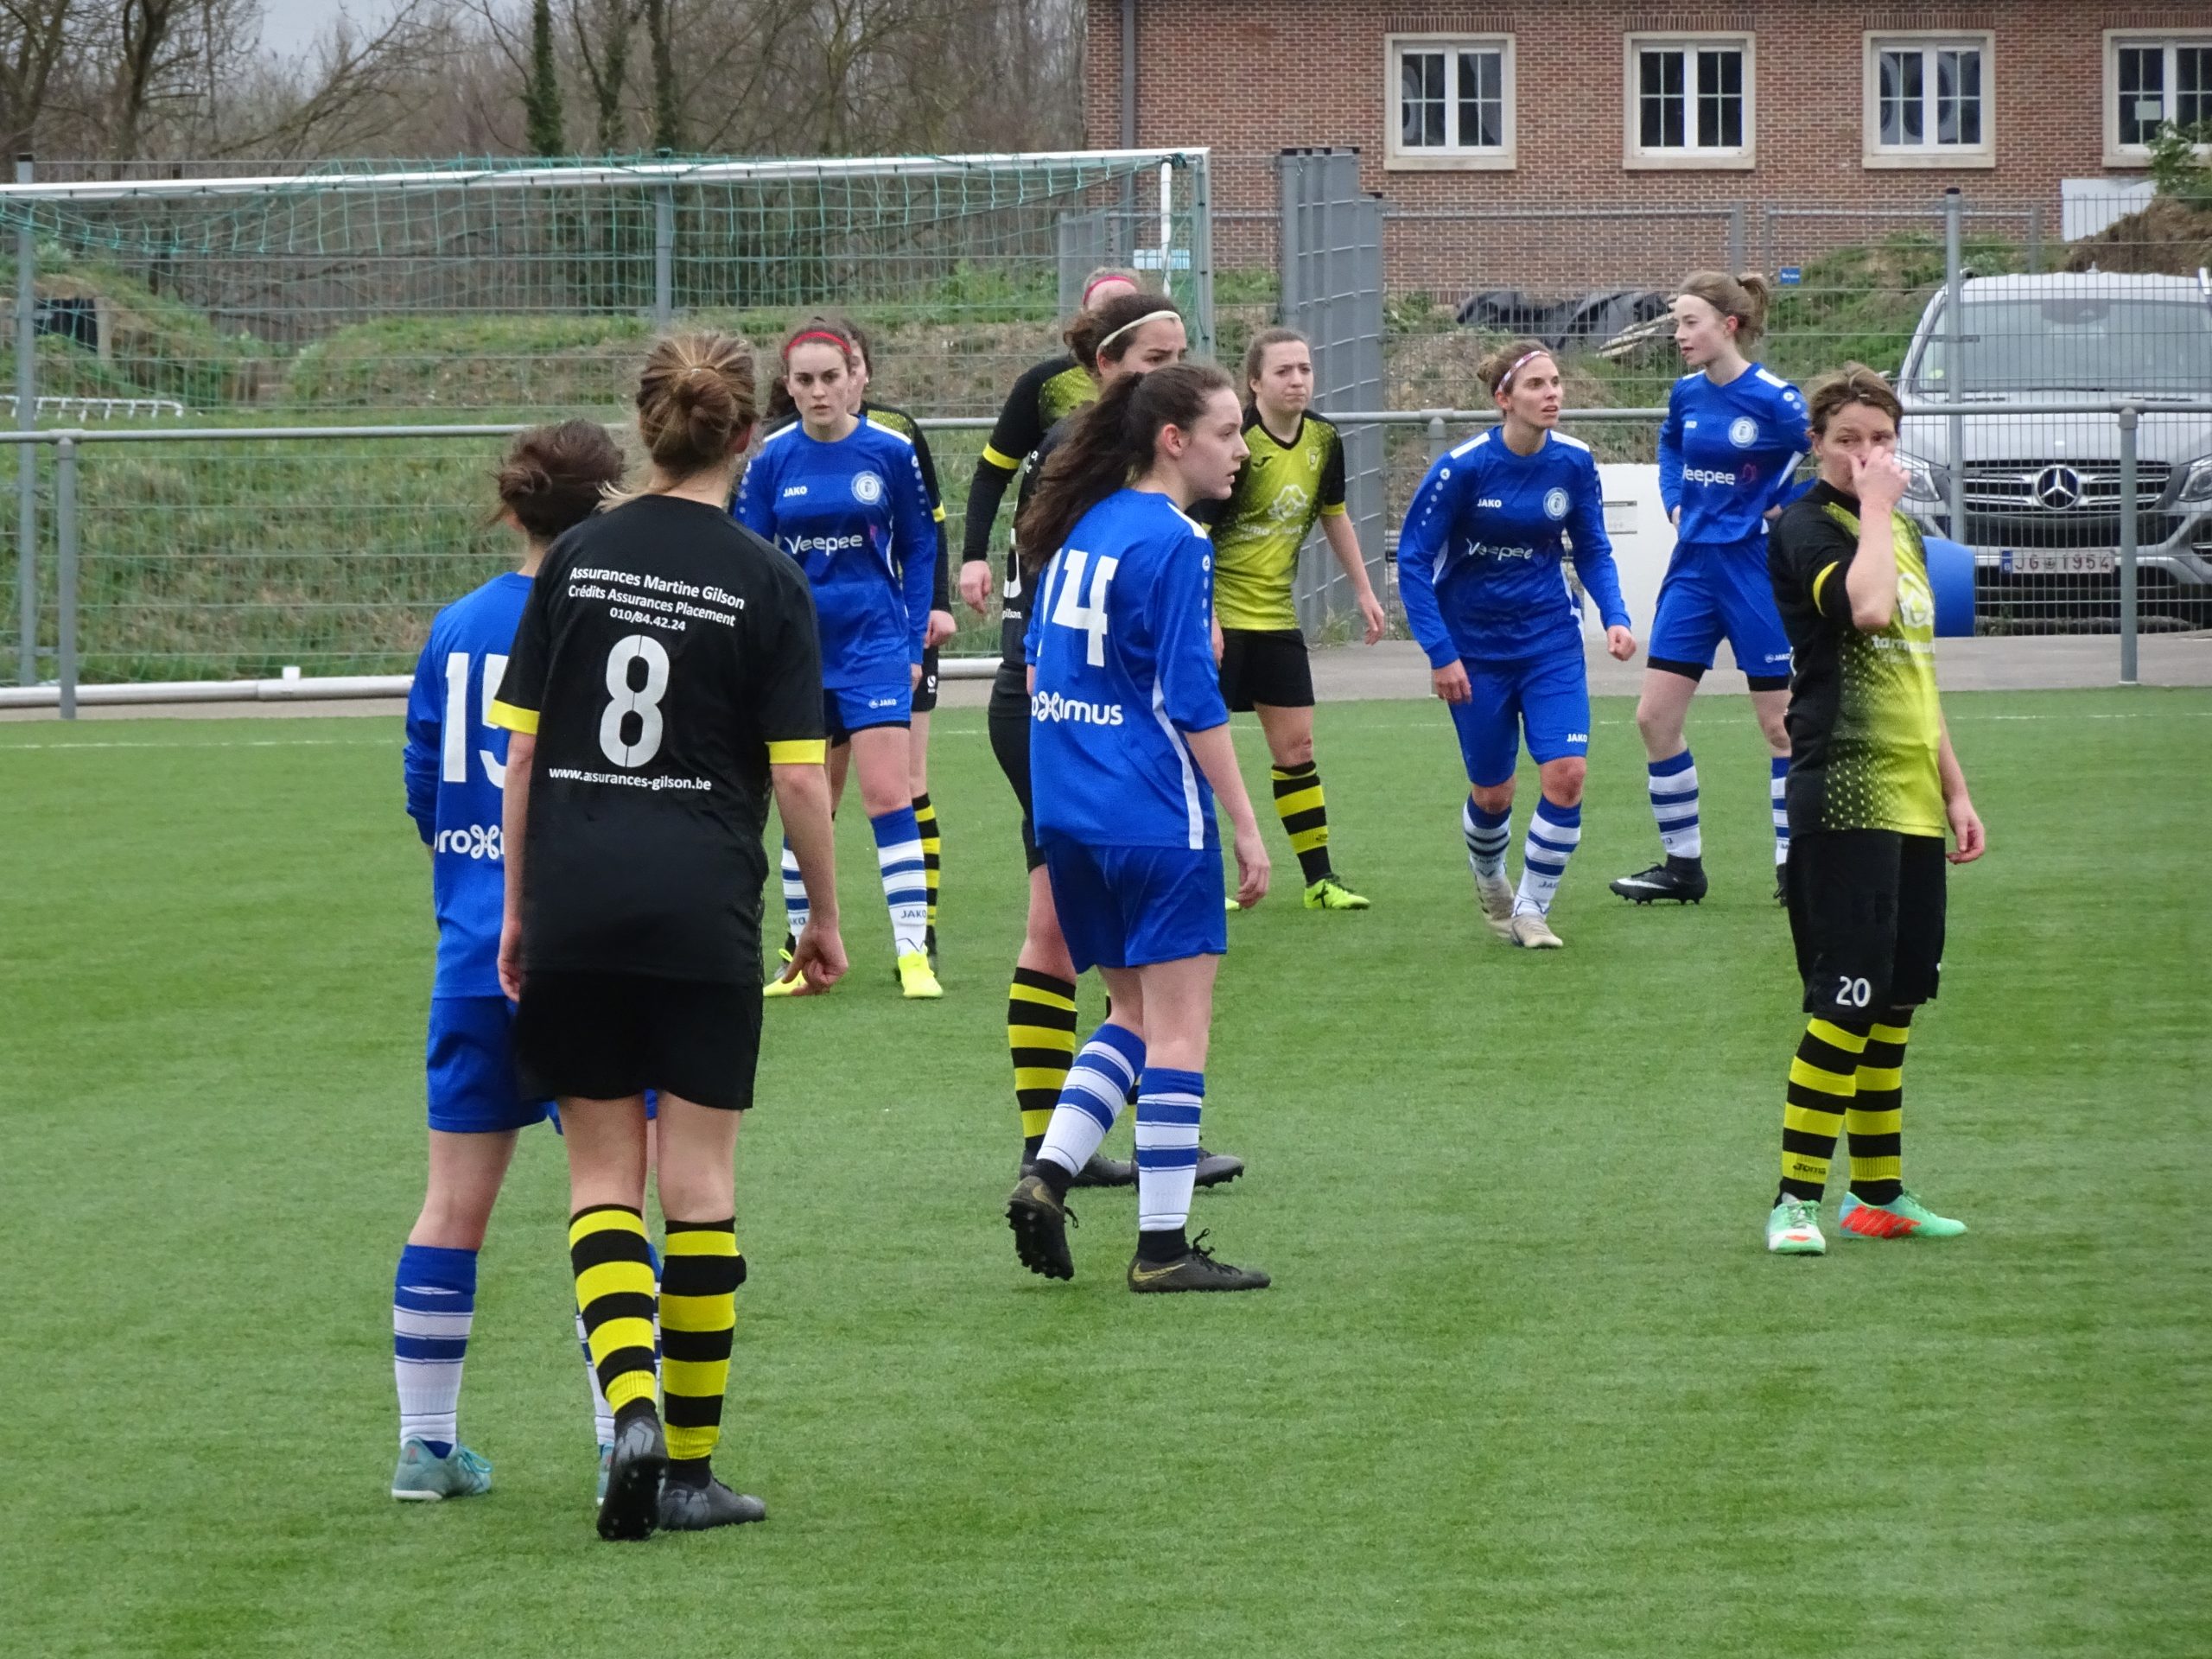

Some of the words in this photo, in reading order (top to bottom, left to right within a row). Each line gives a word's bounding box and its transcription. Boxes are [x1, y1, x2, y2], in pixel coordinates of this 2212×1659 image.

[783, 486, 808, 498] JAKO
[1477, 498, 1502, 508] JAKO
[785, 534, 863, 556] Veepee
[1465, 537, 1534, 562] Veepee
[569, 567, 641, 586] Assurances
[644, 574, 700, 598] Martine
[702, 585, 746, 610] Gilson
[568, 584, 607, 600] Crédits
[607, 588, 674, 613] Assurances
[675, 601, 736, 627] Placement
[1037, 548, 1118, 668] 14
[609, 607, 687, 632] 010/84.42.24
[600, 634, 670, 768] 8
[1567, 733, 1588, 742] JAKO
[901, 909, 927, 919] JAKO
[1835, 976, 1872, 1007] 20
